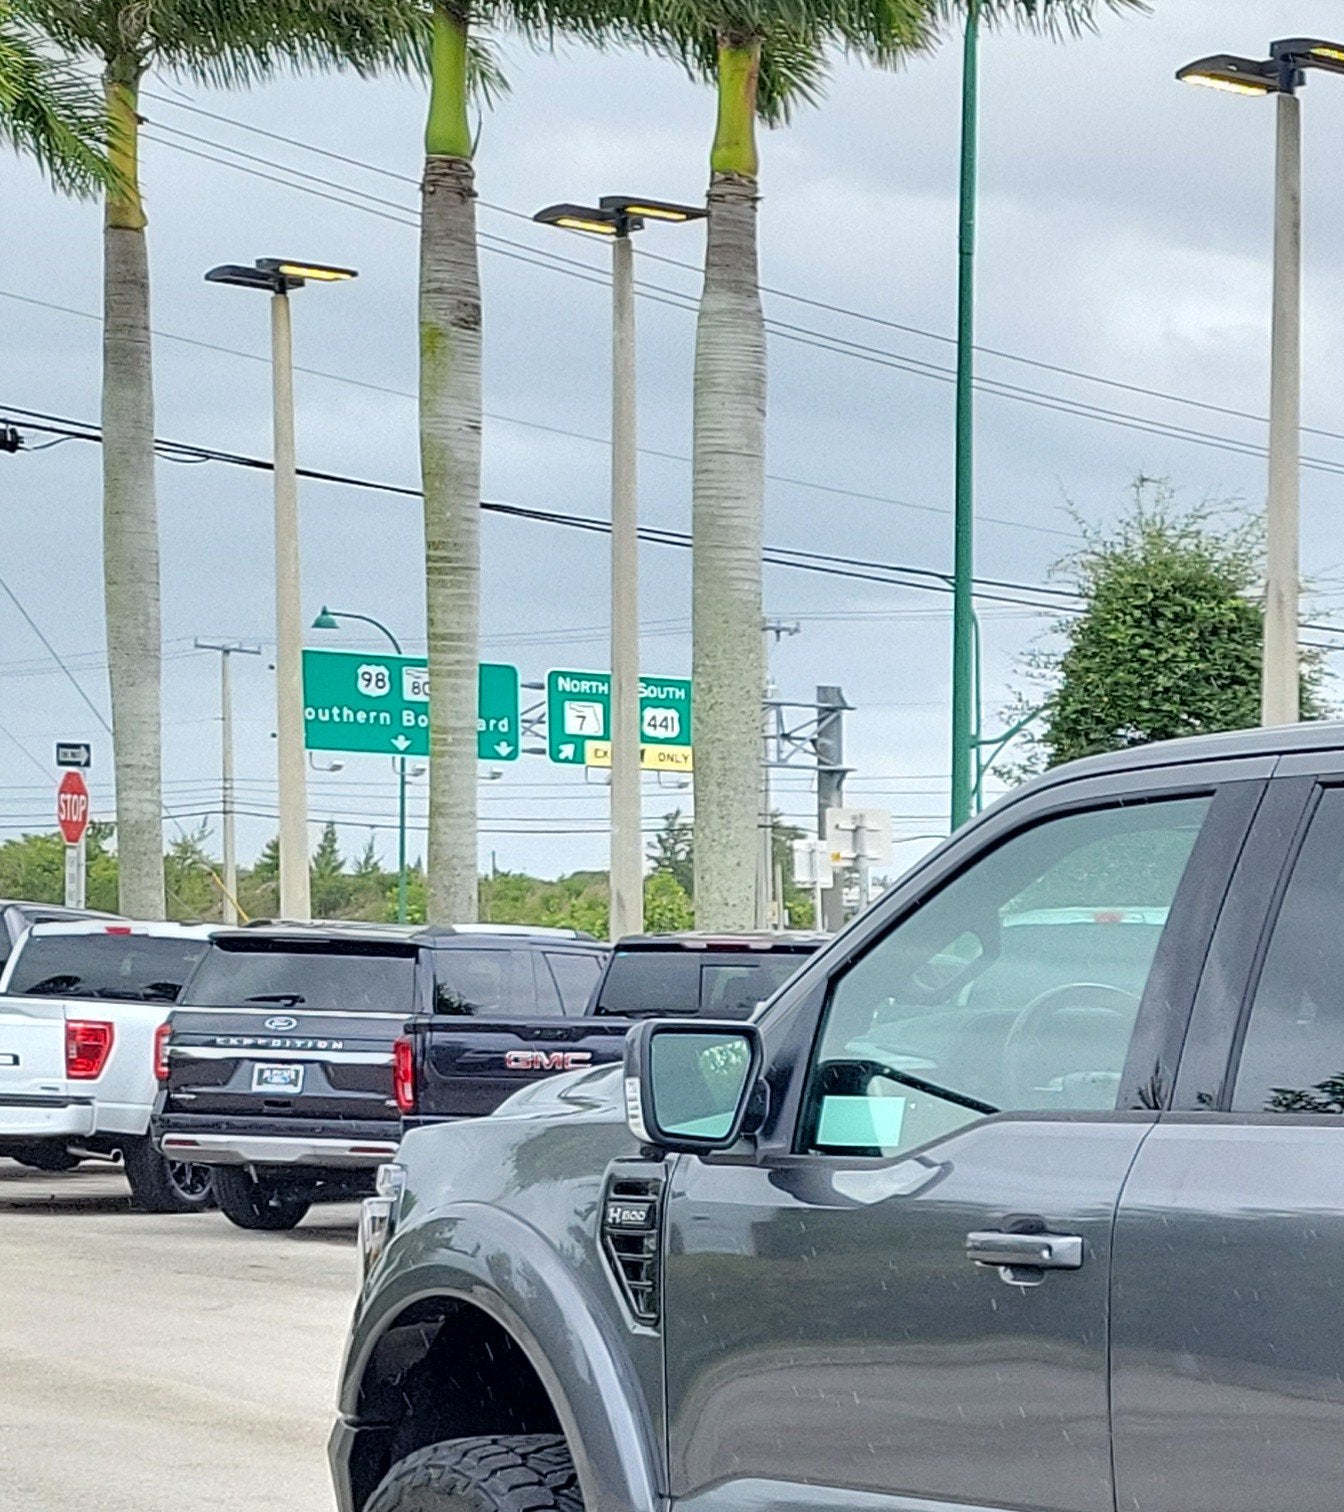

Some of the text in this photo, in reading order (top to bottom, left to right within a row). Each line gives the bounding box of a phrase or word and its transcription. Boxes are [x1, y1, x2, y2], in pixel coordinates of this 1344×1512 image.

[361, 671, 387, 690] 98
[557, 676, 609, 695] NORTH
[638, 682, 686, 700] SOUTH
[304, 706, 391, 726] outhern
[574, 715, 587, 731] 7
[647, 715, 675, 733] 441
[594, 748, 690, 764] EX ONLY
[59, 793, 87, 823] STOP
[213, 1035, 344, 1051] EXPEDITION
[505, 1050, 593, 1071] GMC
